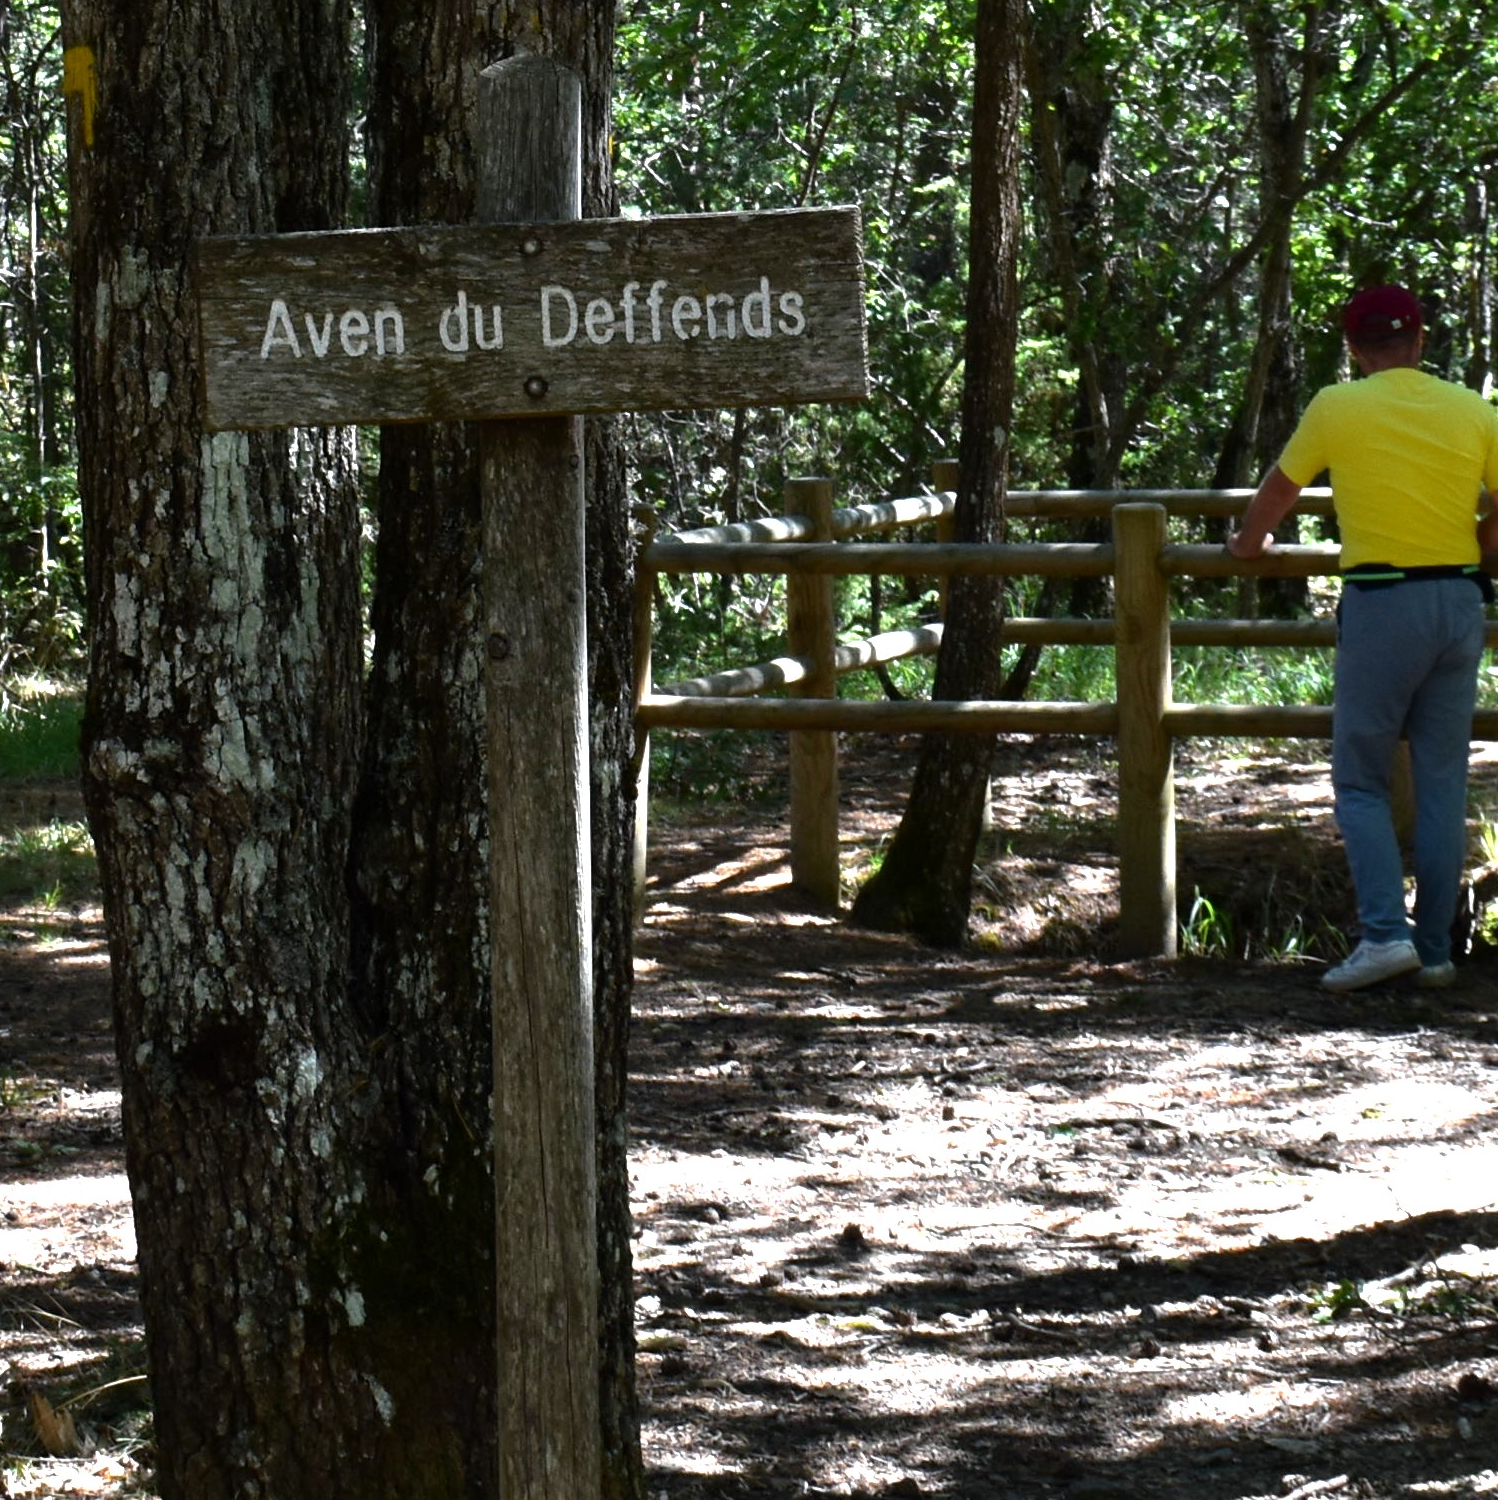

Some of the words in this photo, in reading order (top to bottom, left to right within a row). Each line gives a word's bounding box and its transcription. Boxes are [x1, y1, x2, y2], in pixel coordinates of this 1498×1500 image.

[260, 299, 405, 360] Aven
[438, 290, 504, 354] du
[540, 275, 806, 348] Deffends
